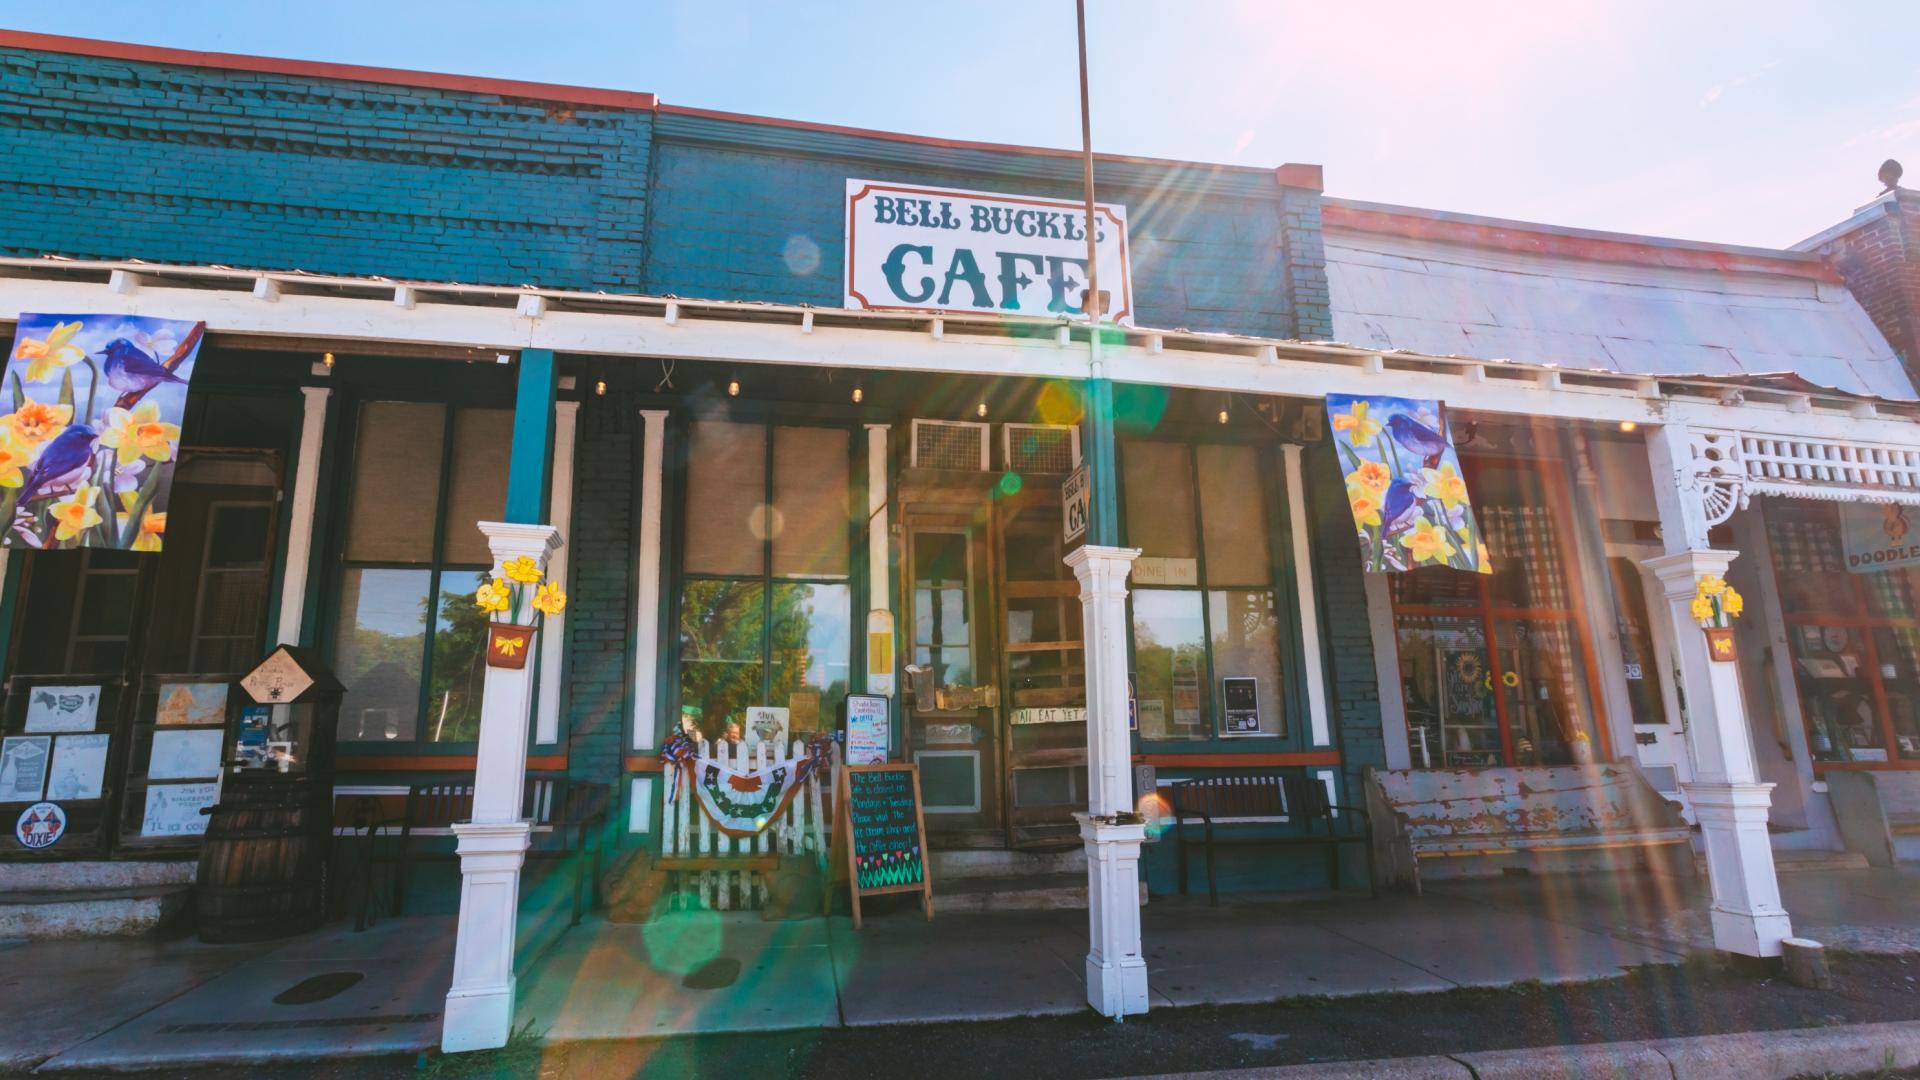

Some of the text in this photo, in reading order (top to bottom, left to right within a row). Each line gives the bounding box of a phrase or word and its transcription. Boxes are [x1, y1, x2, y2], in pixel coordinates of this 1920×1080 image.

[874, 195, 1105, 243] BELL BUCKLE
[881, 243, 1091, 314] CAFE
[1069, 498, 1086, 531] CA
[1134, 564, 1187, 577] DINE IN
[1038, 708, 1057, 722] EAT
[1062, 708, 1080, 721] YET
[185, 822, 207, 831] COL
[25, 831, 53, 847] DIXIE
